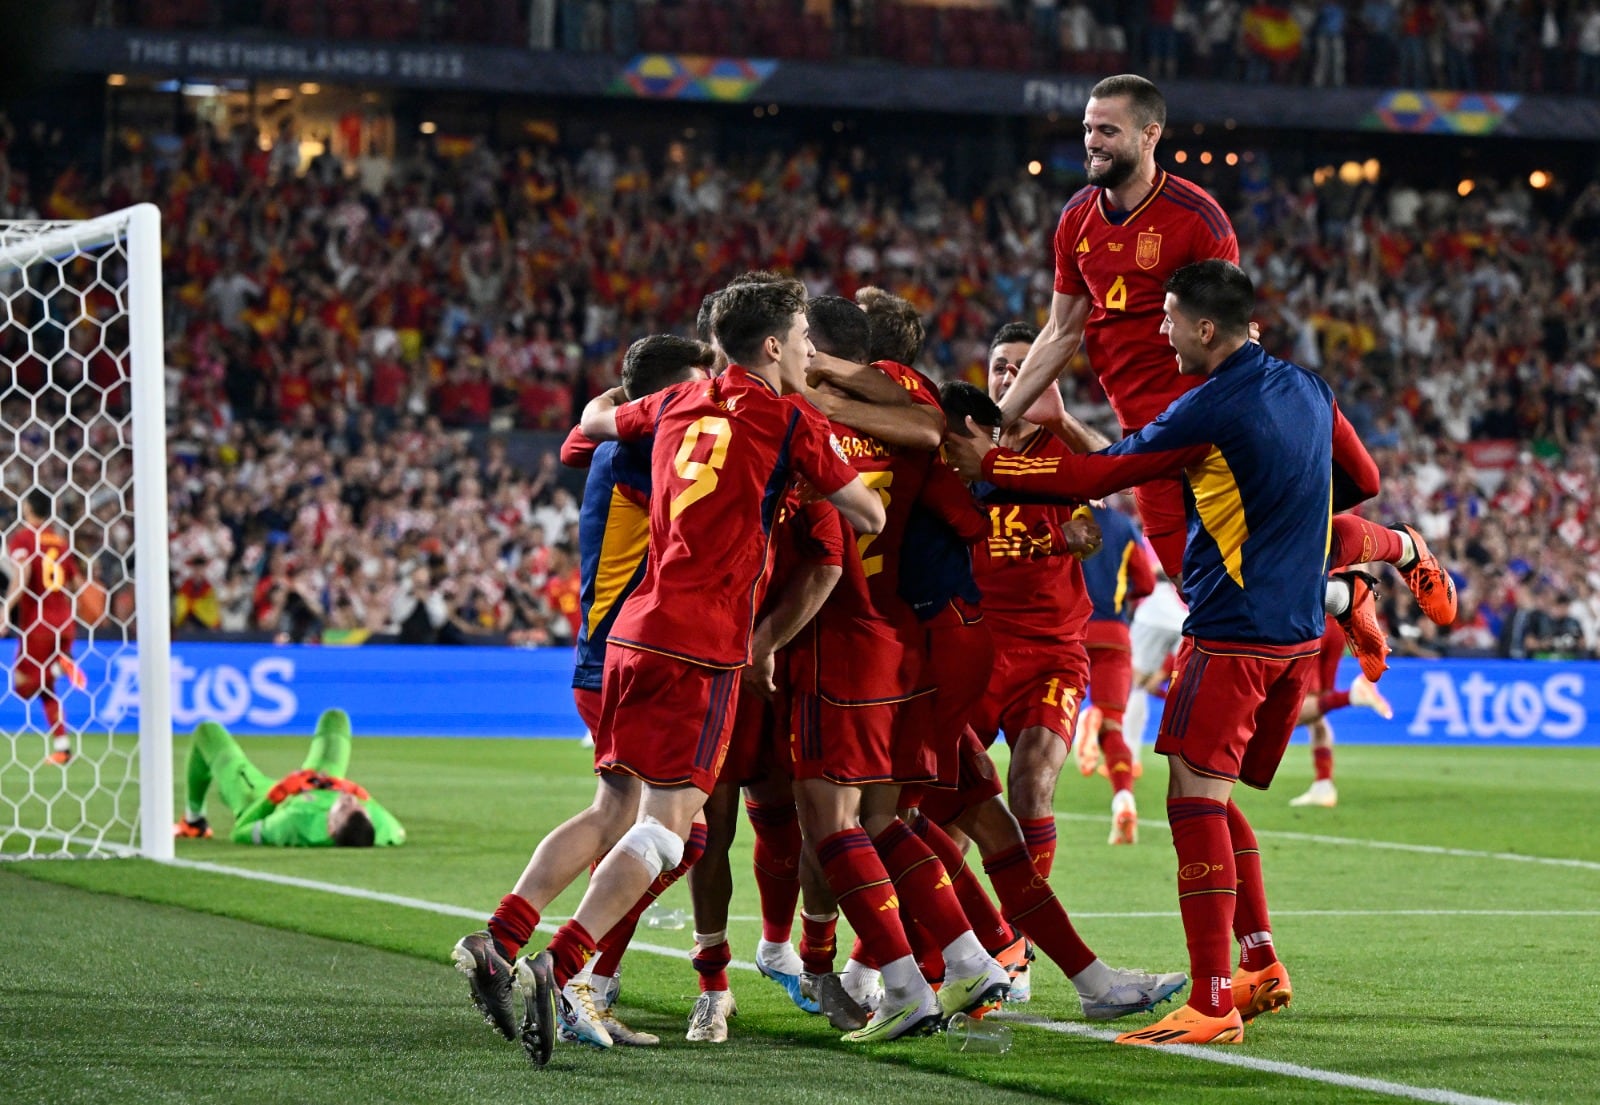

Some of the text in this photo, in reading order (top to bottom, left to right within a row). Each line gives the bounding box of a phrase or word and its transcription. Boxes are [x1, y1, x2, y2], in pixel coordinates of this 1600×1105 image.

[128, 38, 178, 65] THE
[187, 44, 390, 75] NETHERLANDS
[1105, 275, 1127, 312] 4
[669, 415, 733, 521] 9
[41, 546, 65, 592] 6
[1041, 677, 1078, 720] 16
[1210, 976, 1220, 1007] DESIGN
